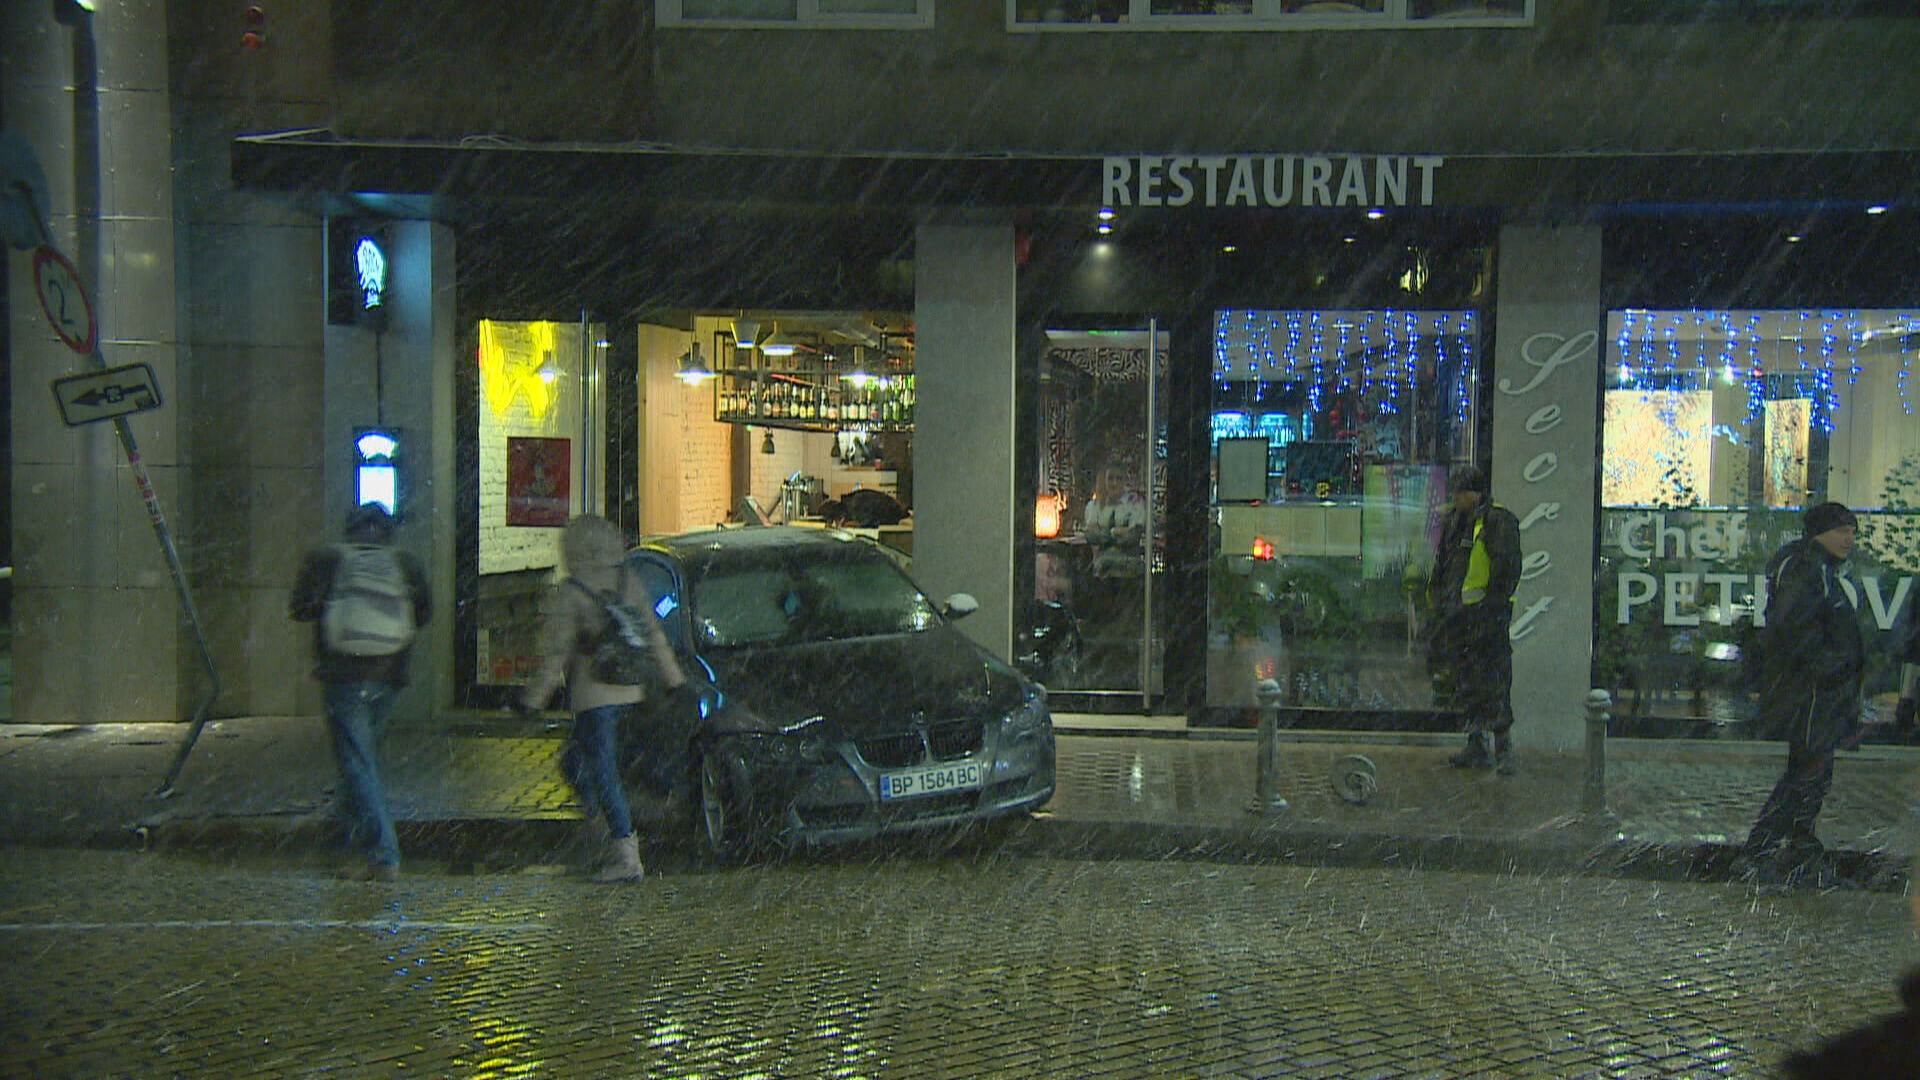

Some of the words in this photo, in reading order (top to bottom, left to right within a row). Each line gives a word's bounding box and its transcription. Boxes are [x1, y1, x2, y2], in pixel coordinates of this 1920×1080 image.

[1102, 156, 1444, 207] RESTAURANT
[1620, 512, 1747, 560] Chef
[919, 770, 955, 791] 1584
